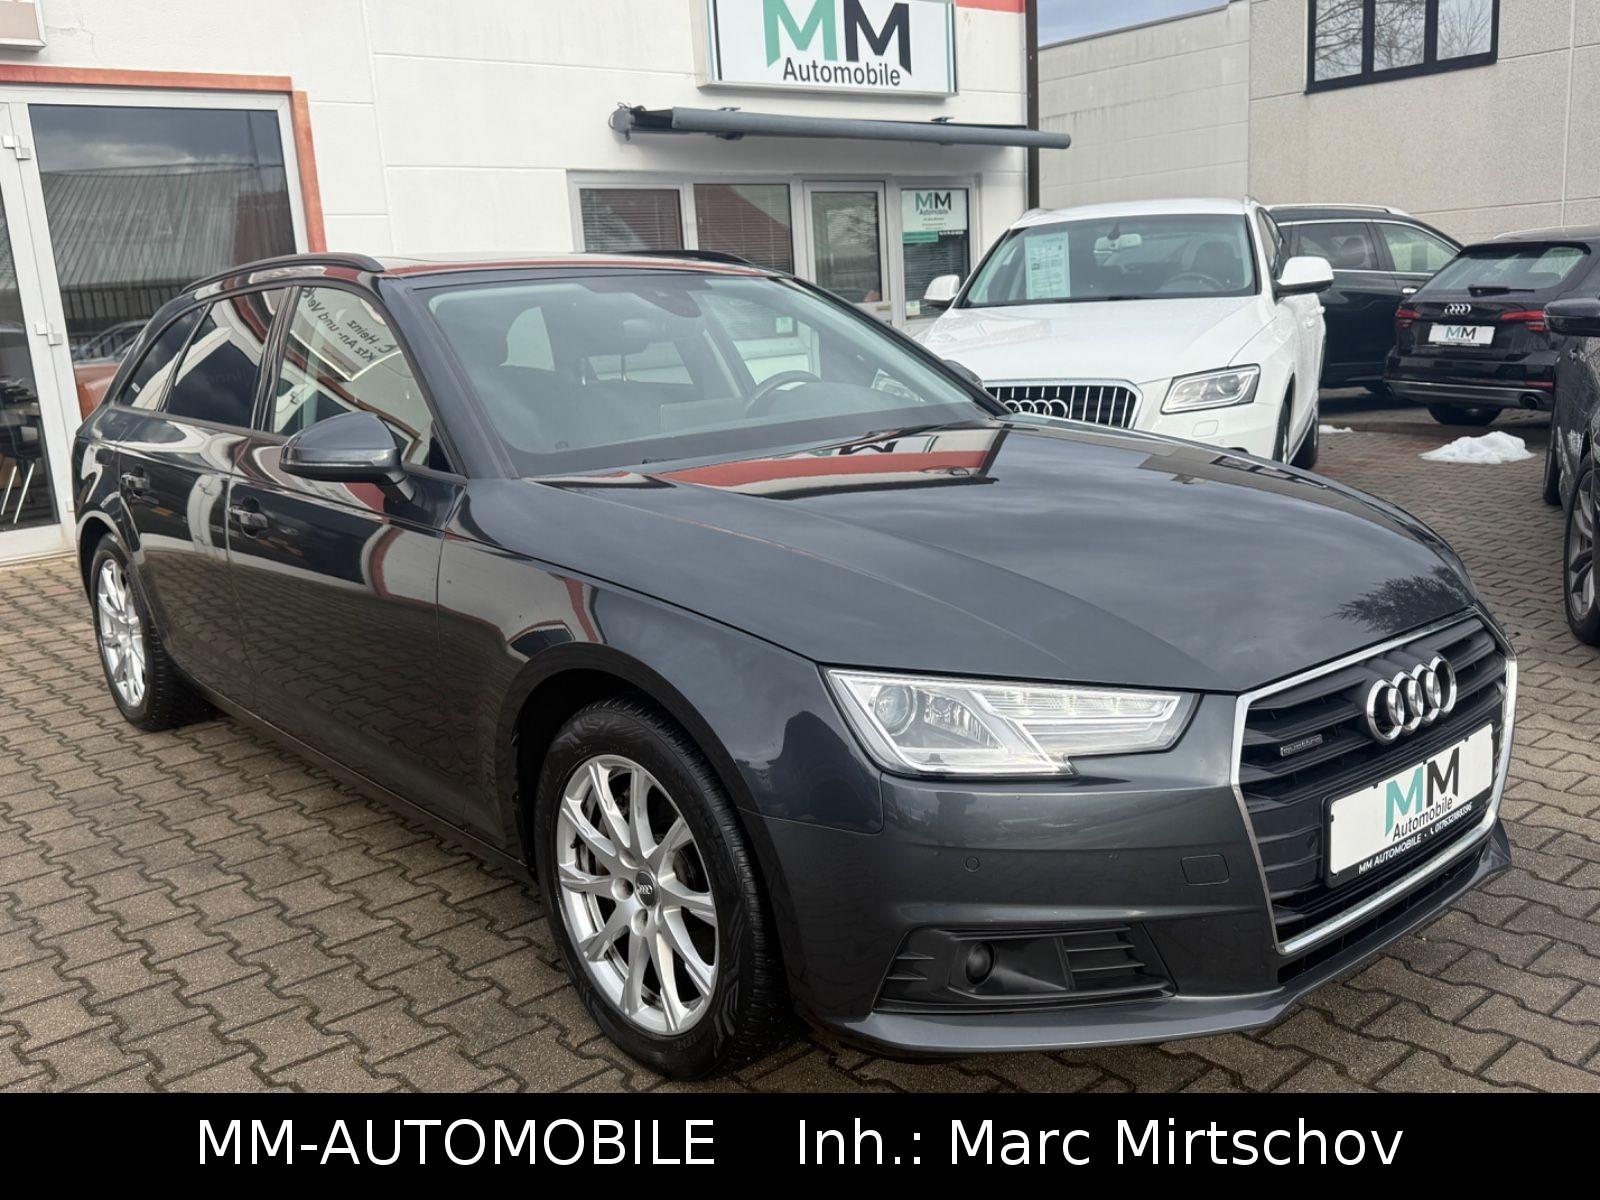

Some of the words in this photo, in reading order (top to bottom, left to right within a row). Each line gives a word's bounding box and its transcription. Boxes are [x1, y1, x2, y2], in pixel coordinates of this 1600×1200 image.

[763, 0, 912, 76] MM
[783, 56, 901, 87] Automobile
[915, 192, 952, 212] MM
[1445, 326, 1477, 341] MM
[1385, 746, 1460, 838] MM
[1393, 796, 1453, 842] Automobile
[1359, 860, 1373, 875] MM
[1374, 833, 1422, 867] AUTOMOBILE
